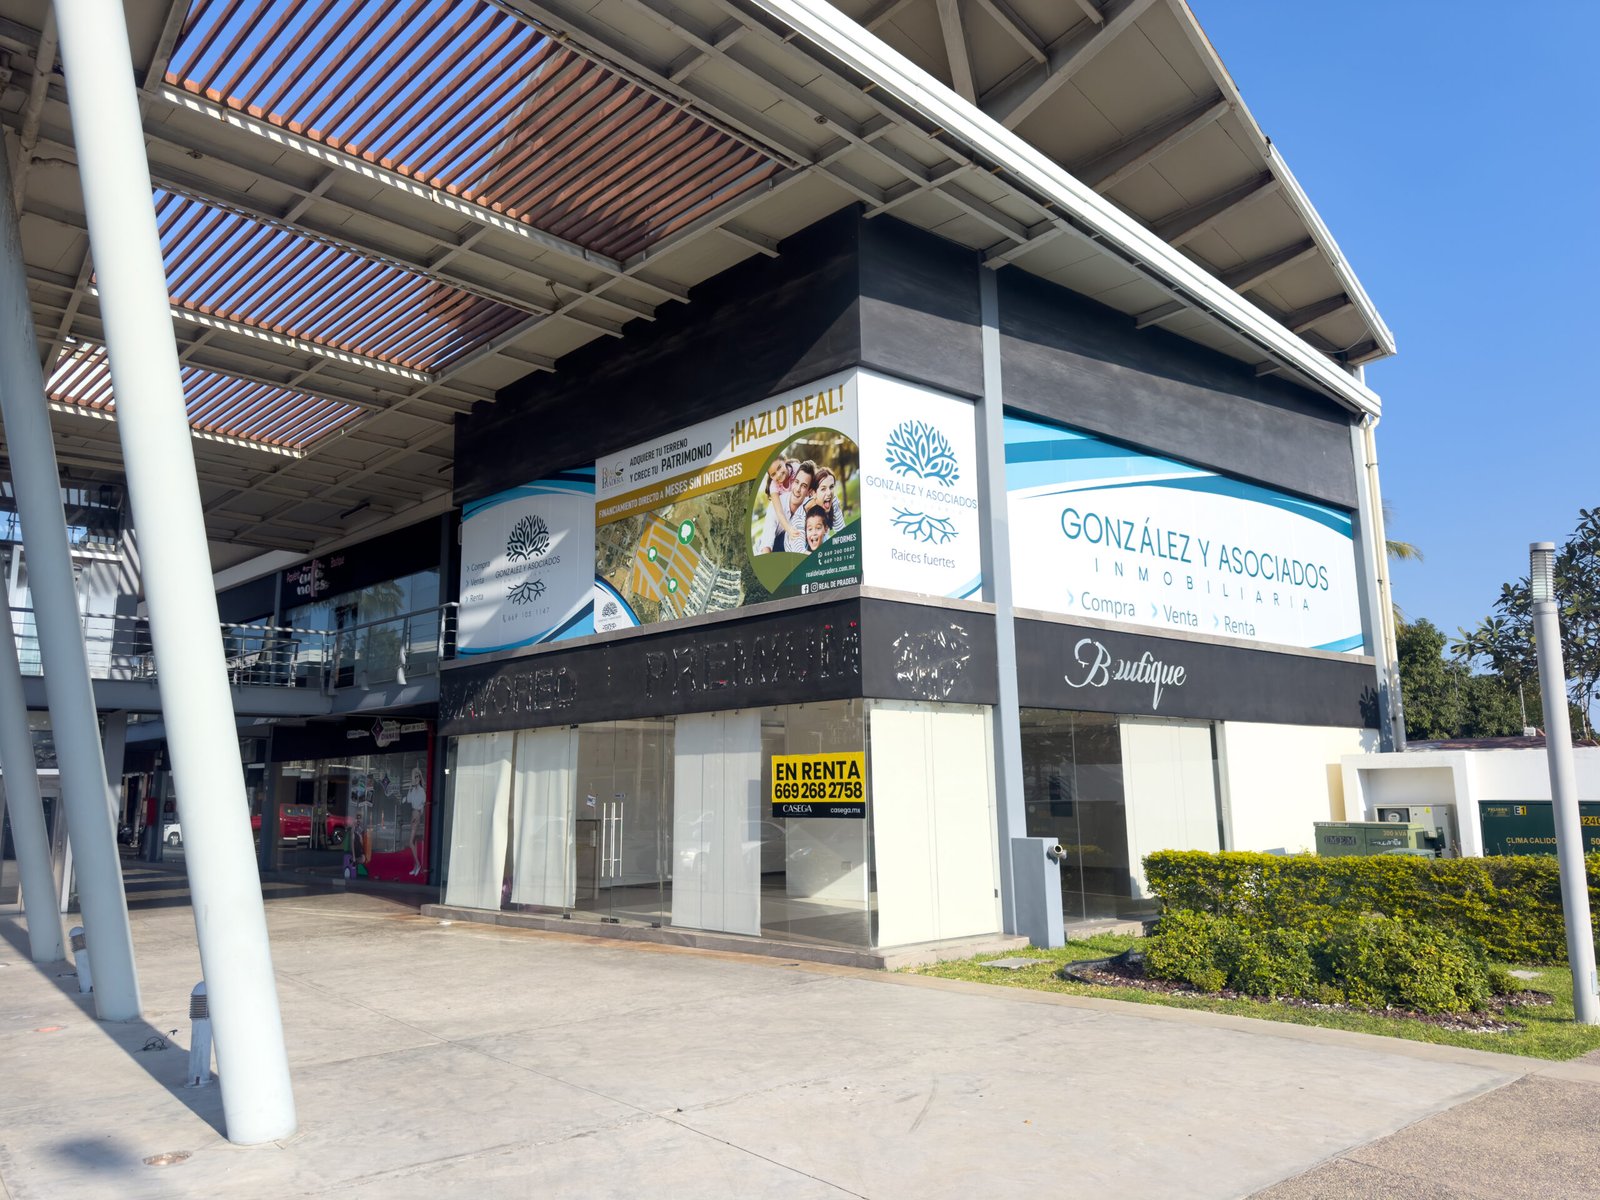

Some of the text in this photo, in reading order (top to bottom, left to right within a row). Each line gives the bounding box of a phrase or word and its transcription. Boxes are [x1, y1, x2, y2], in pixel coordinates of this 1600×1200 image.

[730, 384, 845, 453] ¡HAZLO REAL!
[629, 438, 688, 467] ADQUIERE TU TERRENO
[629, 442, 713, 483] Y CRECE TU PATRIMONIO
[598, 497, 638, 518] FINANCIAMIENTO
[638, 491, 660, 507] DIRECTO
[664, 480, 688, 498] MESES
[689, 475, 702, 490] SIN
[703, 462, 743, 486] INTERESES
[917, 485, 924, 497] Y
[925, 489, 978, 510] ASOCIADOS
[832, 533, 857, 545] INFORMES
[1061, 507, 1330, 591] GONZÁLEZ Y ASOCIADOS
[470, 560, 491, 573] Compra
[527, 555, 561, 571] ASOCIADOS
[923, 554, 956, 569] fuertes
[470, 577, 485, 587] Venta
[818, 577, 858, 590] REAL DE PRADERA
[1081, 591, 1256, 636] Compra Venta Renta
[776, 760, 861, 781] EN RENTA
[774, 781, 863, 799] 669 268 2758
[782, 804, 813, 813] CASEGA
[830, 807, 861, 815] casega.mx
[1506, 836, 1557, 845] CLIMA CALIDO
